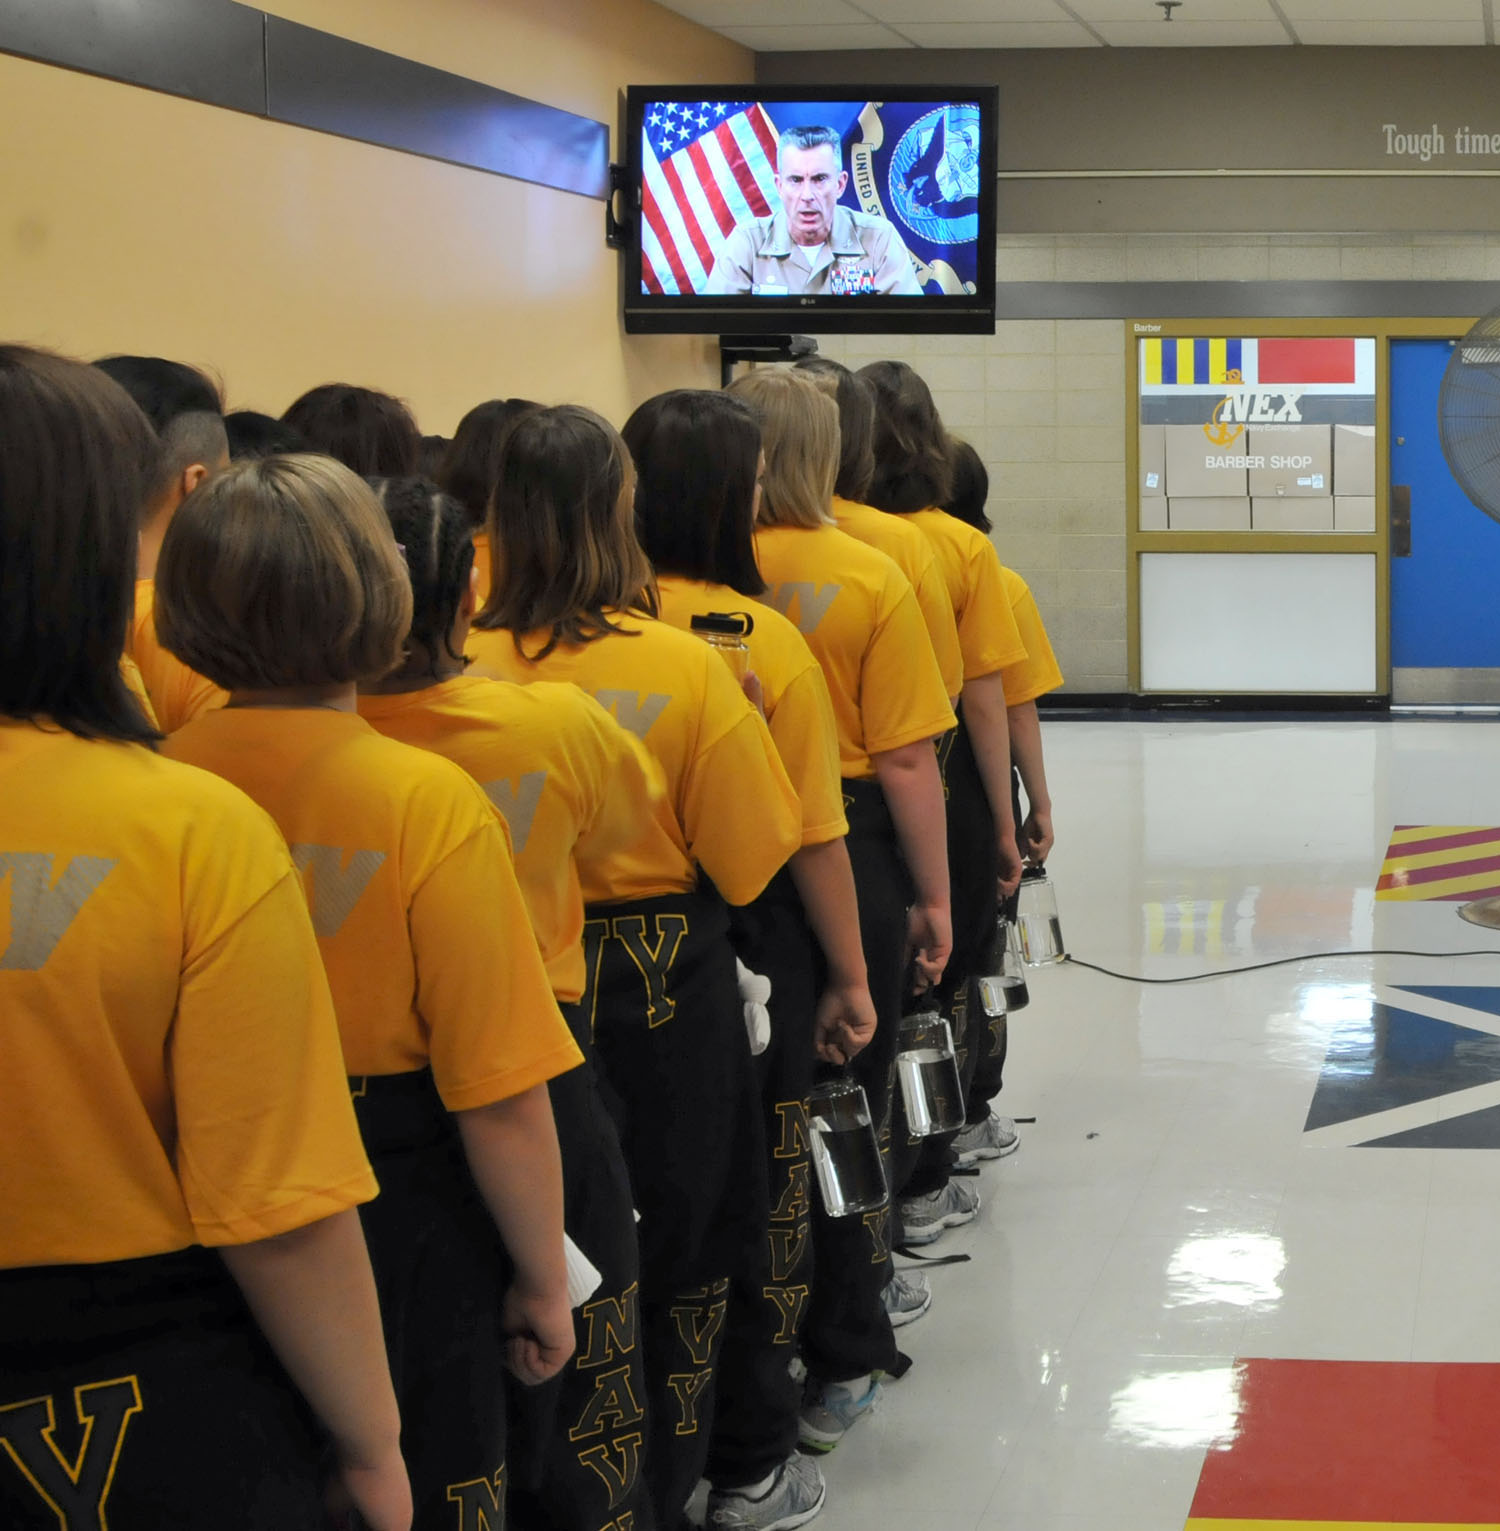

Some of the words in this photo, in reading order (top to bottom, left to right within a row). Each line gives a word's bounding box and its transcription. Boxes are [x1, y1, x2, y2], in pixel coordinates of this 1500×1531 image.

[1383, 124, 1445, 161] Tough
[856, 153, 873, 199] UNITED
[1134, 323, 1161, 332] Barber
[1219, 391, 1304, 422] NEX
[1206, 456, 1265, 469] BARBER
[1270, 456, 1313, 469] SHOP
